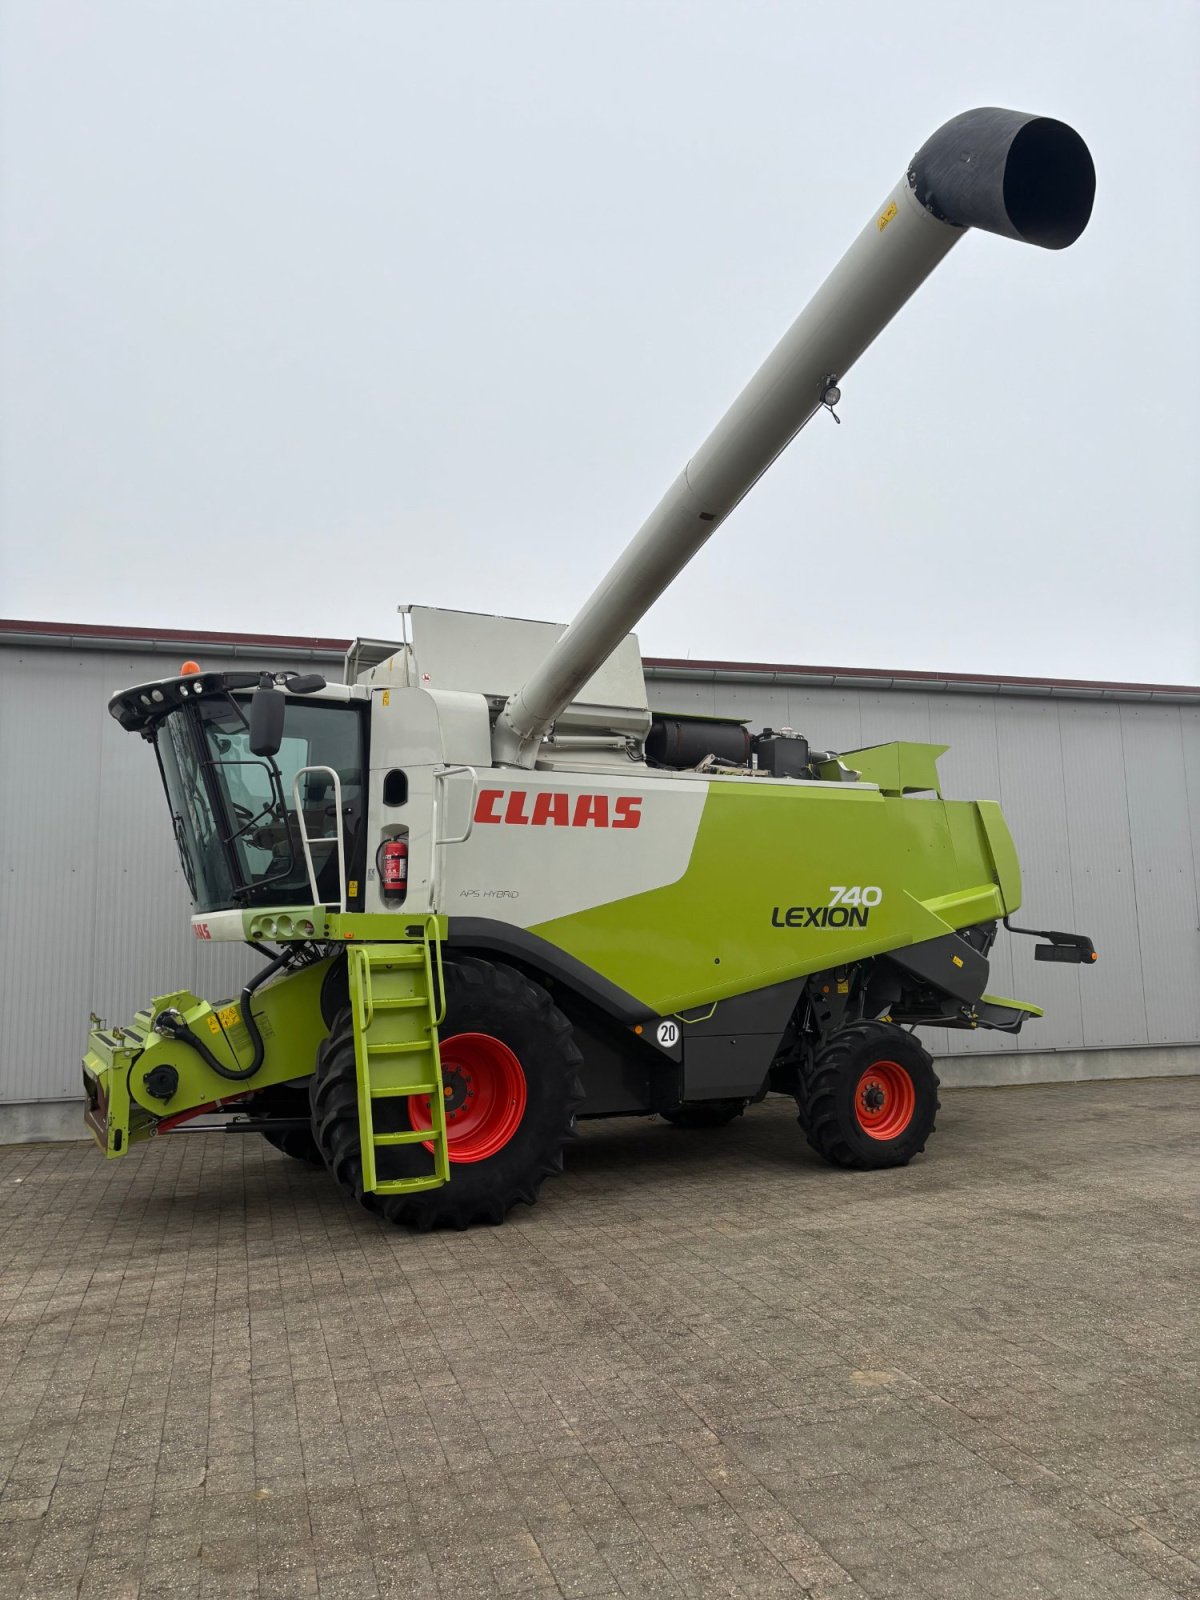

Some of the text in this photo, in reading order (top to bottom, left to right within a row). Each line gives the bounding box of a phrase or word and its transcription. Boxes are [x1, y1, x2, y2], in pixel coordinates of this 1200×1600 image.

[473, 790, 643, 829] CLAAS
[459, 889, 481, 898] APS
[828, 886, 883, 907] 740
[771, 907, 869, 928] LEXION
[660, 1024, 675, 1042] 20
